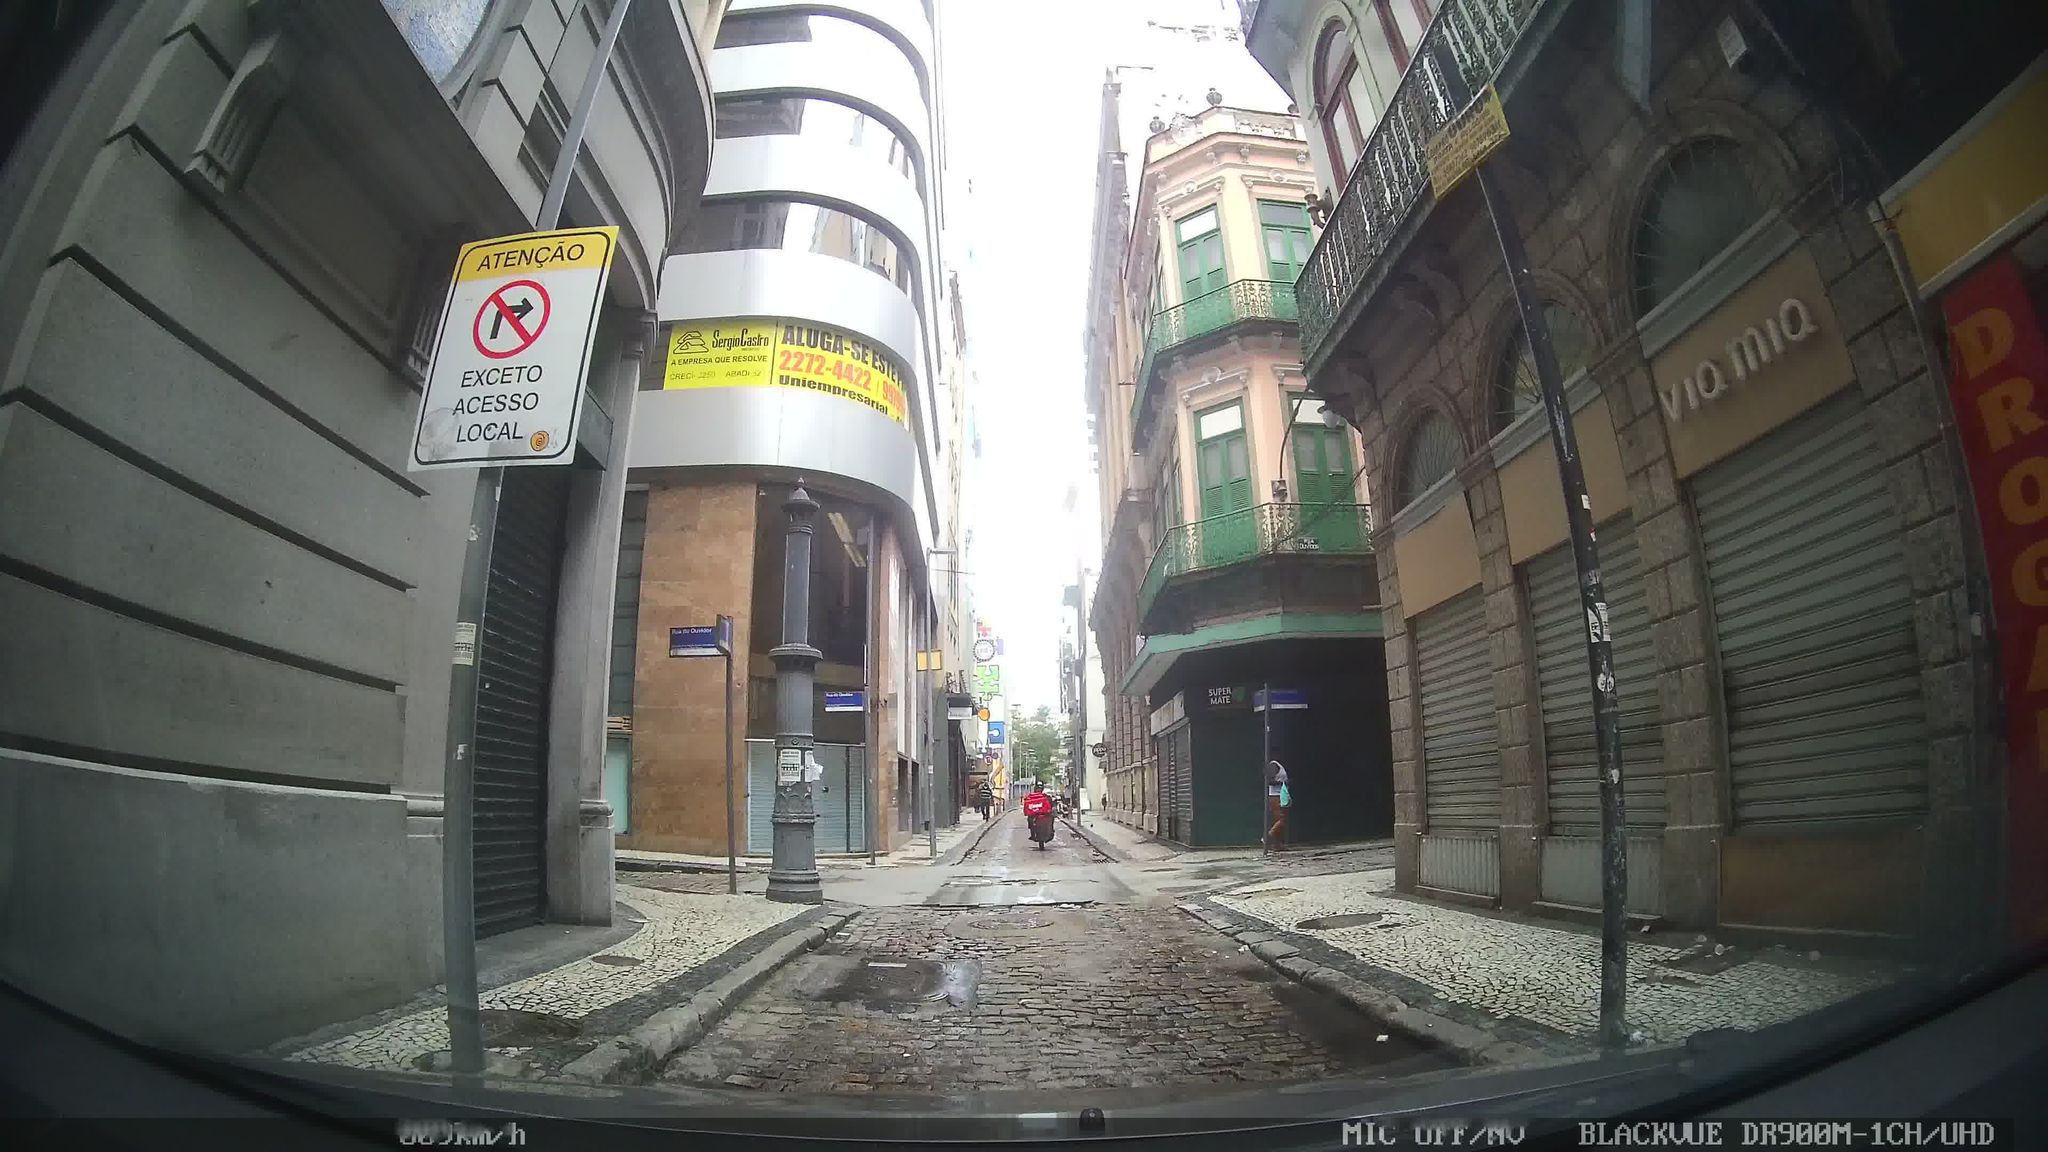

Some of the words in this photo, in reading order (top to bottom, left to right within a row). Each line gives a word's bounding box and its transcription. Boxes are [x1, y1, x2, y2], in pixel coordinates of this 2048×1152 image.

[477, 241, 585, 272] ATENÇÃO
[781, 325, 869, 366] ALUGA-SE
[678, 357, 713, 365] EMPRESA
[779, 350, 872, 392] 2272-4422
[461, 364, 543, 388] EXCETO
[452, 392, 539, 416] ACESSO
[779, 374, 888, 416] Uniempresarial
[456, 422, 524, 443] LOCAL
[1208, 687, 1232, 697] SUPER
[1210, 696, 1231, 705] MATE
